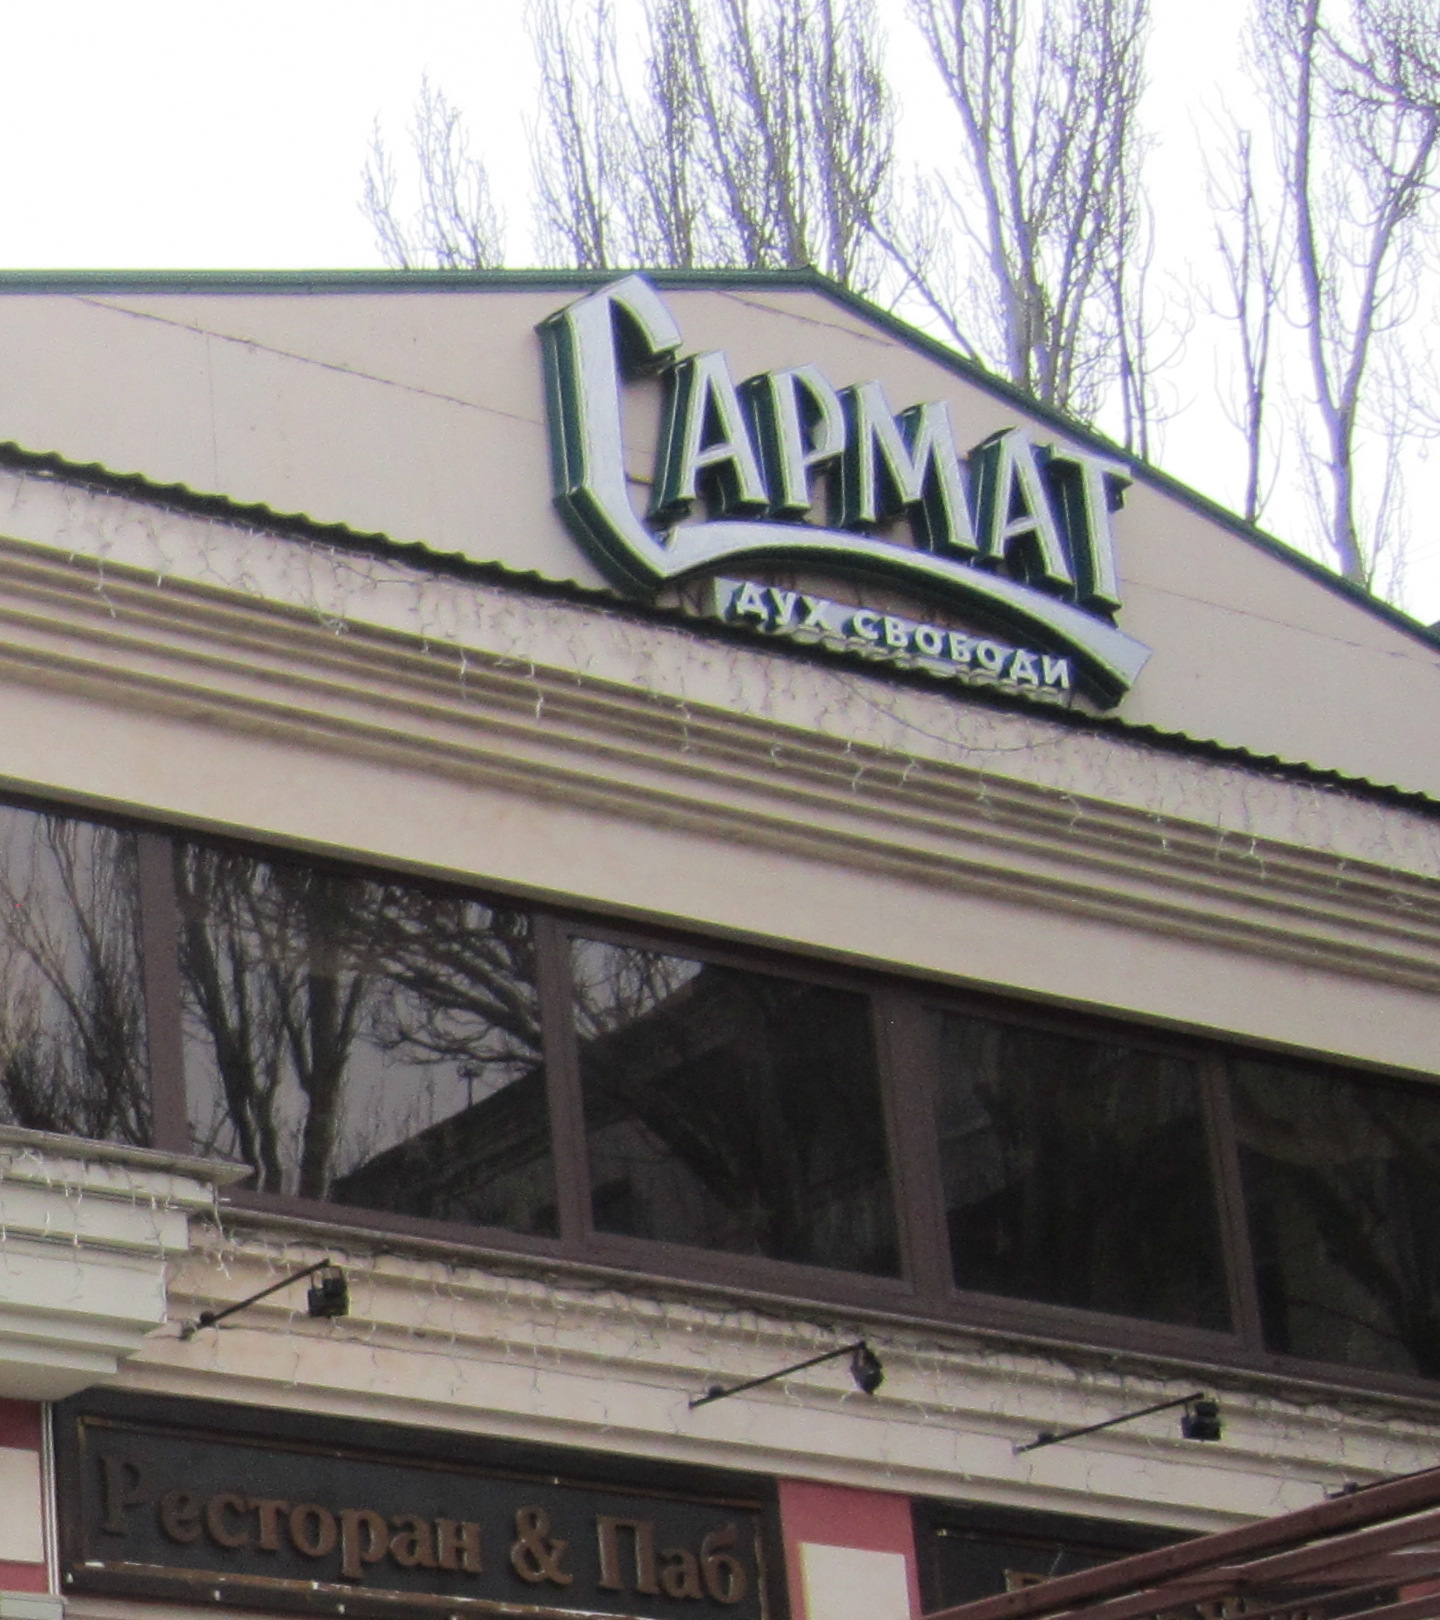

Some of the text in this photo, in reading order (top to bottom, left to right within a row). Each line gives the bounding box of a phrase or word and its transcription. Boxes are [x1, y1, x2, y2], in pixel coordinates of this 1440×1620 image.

[536, 274, 1152, 680] САРМАТ
[730, 580, 1072, 691] ДУХ СВОБОДИ
[99, 1455, 746, 1606] Ресторан & Паб
